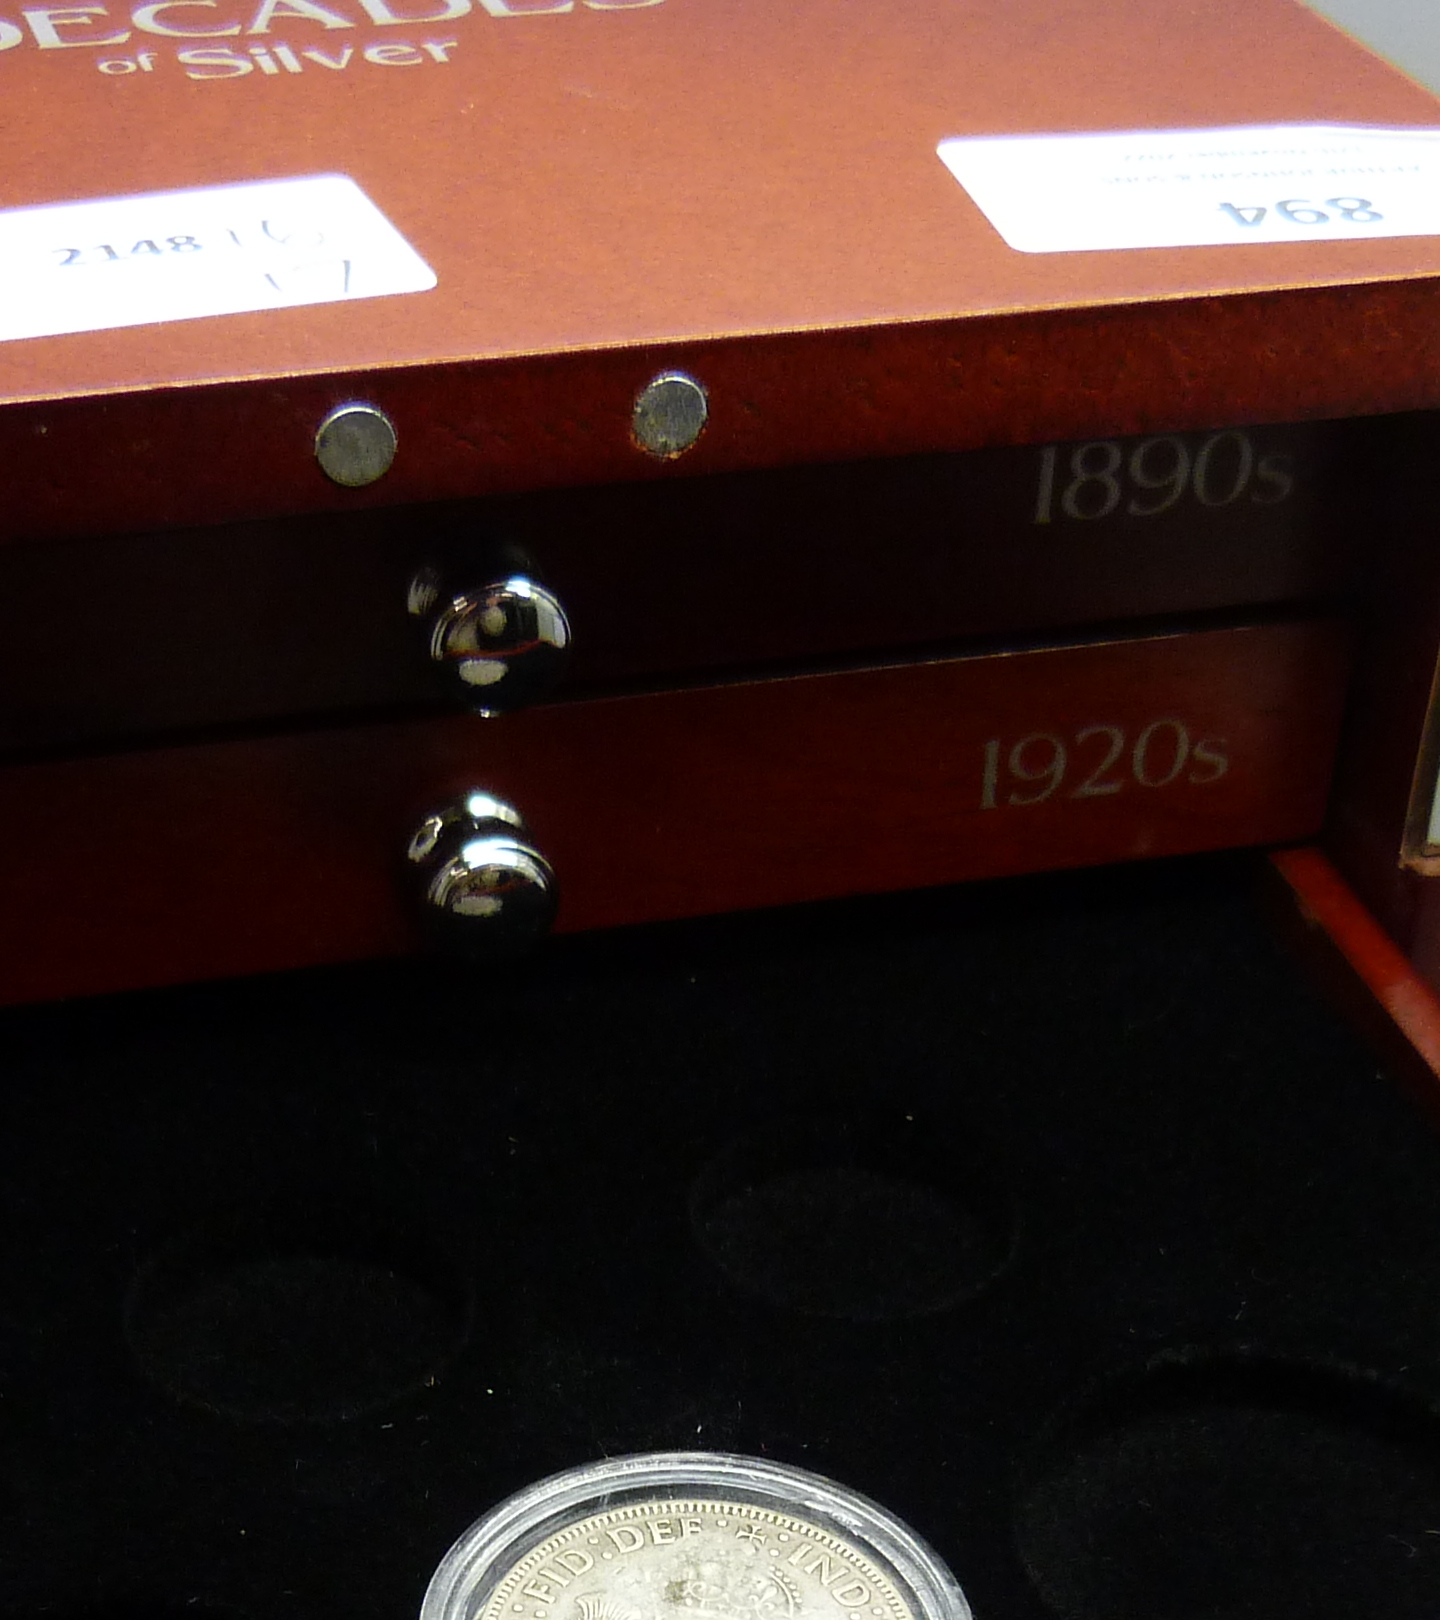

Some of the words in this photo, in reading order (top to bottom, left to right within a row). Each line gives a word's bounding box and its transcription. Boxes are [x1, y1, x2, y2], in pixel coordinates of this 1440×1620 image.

[98, 51, 158, 76] of
[177, 37, 459, 81] Silver
[1217, 197, 1385, 228] 894
[52, 235, 202, 266] 2148
[1032, 431, 1298, 525] 1890s
[978, 720, 1230, 811] 1920s
